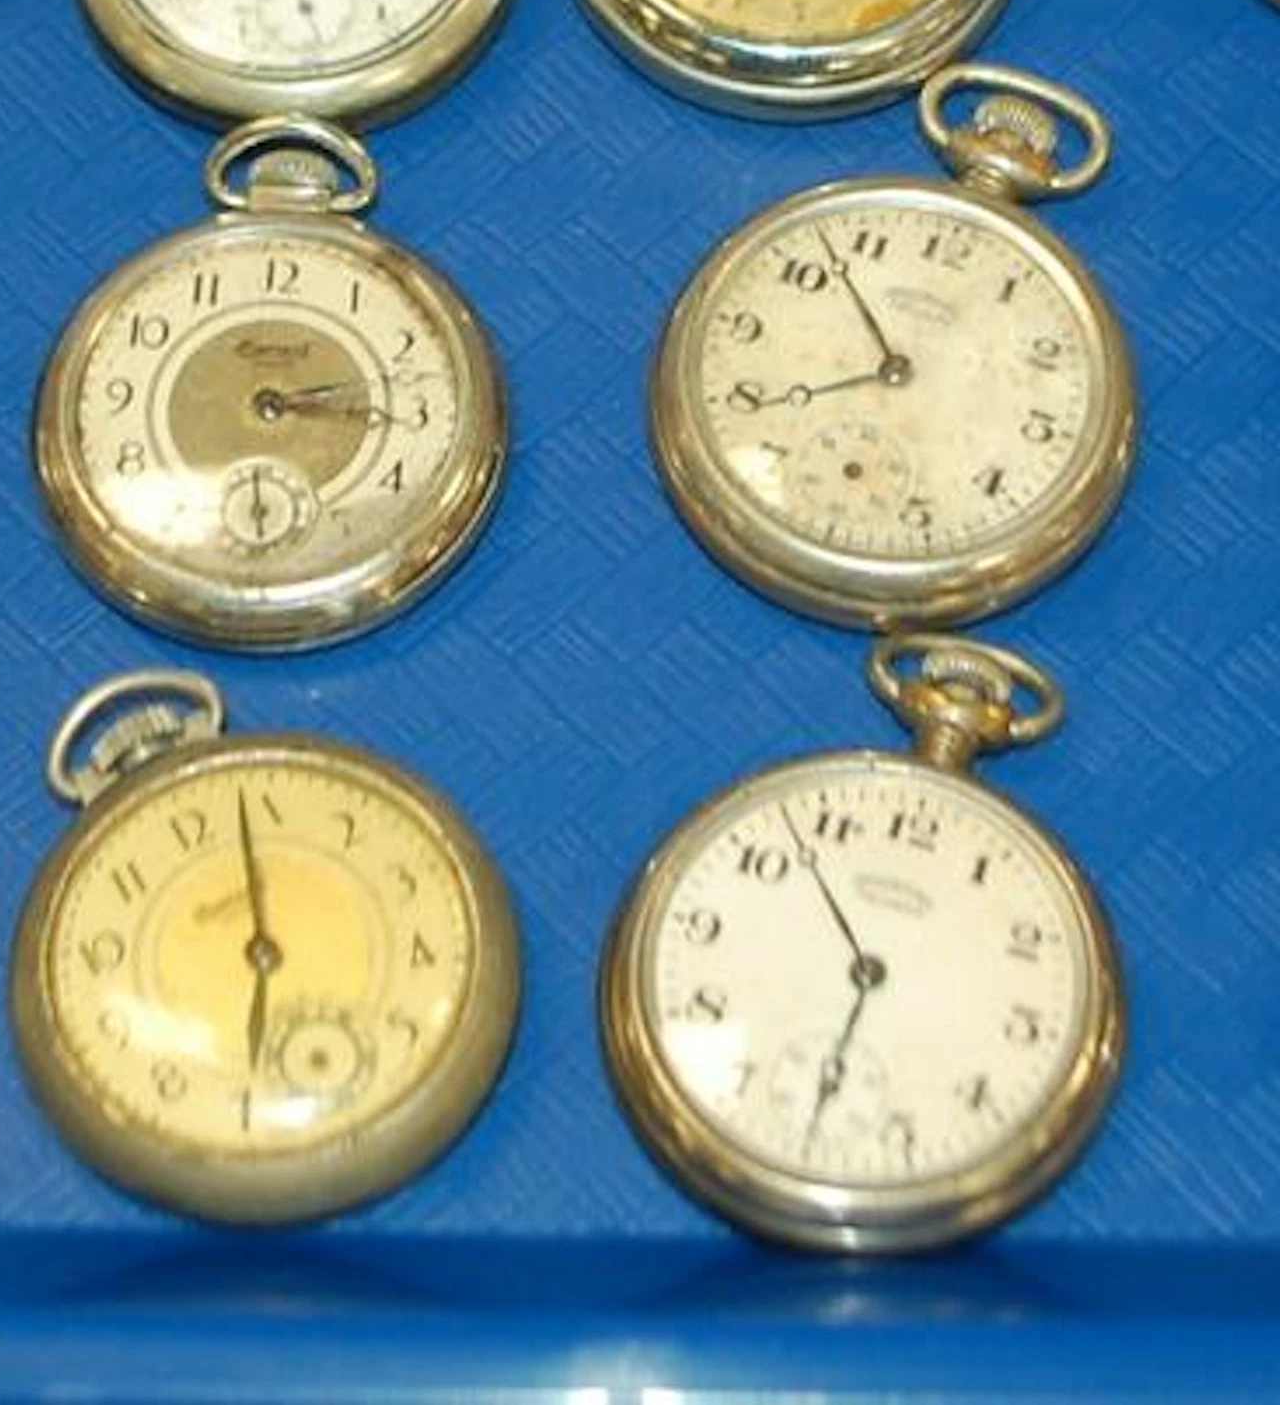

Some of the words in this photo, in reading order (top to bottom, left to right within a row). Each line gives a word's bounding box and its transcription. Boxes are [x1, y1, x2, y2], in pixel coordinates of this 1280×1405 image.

[853, 231, 889, 260] 11
[921, 235, 972, 268] 12
[193, 273, 218, 306] 11
[265, 257, 300, 293] 12
[780, 258, 828, 292] 10
[997, 278, 1017, 303] 1
[350, 282, 361, 314] 1
[130, 314, 170, 348] 10
[728, 313, 763, 344] 9
[392, 329, 415, 365] 2
[1026, 337, 1060, 371] 2
[104, 381, 134, 413] 9
[727, 381, 763, 413] 8
[1021, 410, 1056, 444] 3
[116, 443, 146, 475] 8
[379, 461, 403, 493] 4
[972, 467, 1006, 497] 4
[899, 498, 932, 528] 5
[262, 791, 282, 825] 1
[168, 808, 207, 851] 12
[338, 812, 356, 848] 2
[814, 809, 853, 843] 11
[887, 811, 940, 852] 12
[389, 864, 417, 897] 3
[737, 844, 790, 885] 10
[969, 855, 989, 885] 1
[112, 861, 146, 903] 11
[684, 907, 722, 946] 9
[1007, 919, 1042, 961] 2
[80, 931, 126, 975] 10
[410, 933, 436, 970] 4
[99, 1009, 131, 1048] 9
[387, 1012, 418, 1048] 5
[1003, 1006, 1041, 1046] 3
[151, 1059, 188, 1099] 8
